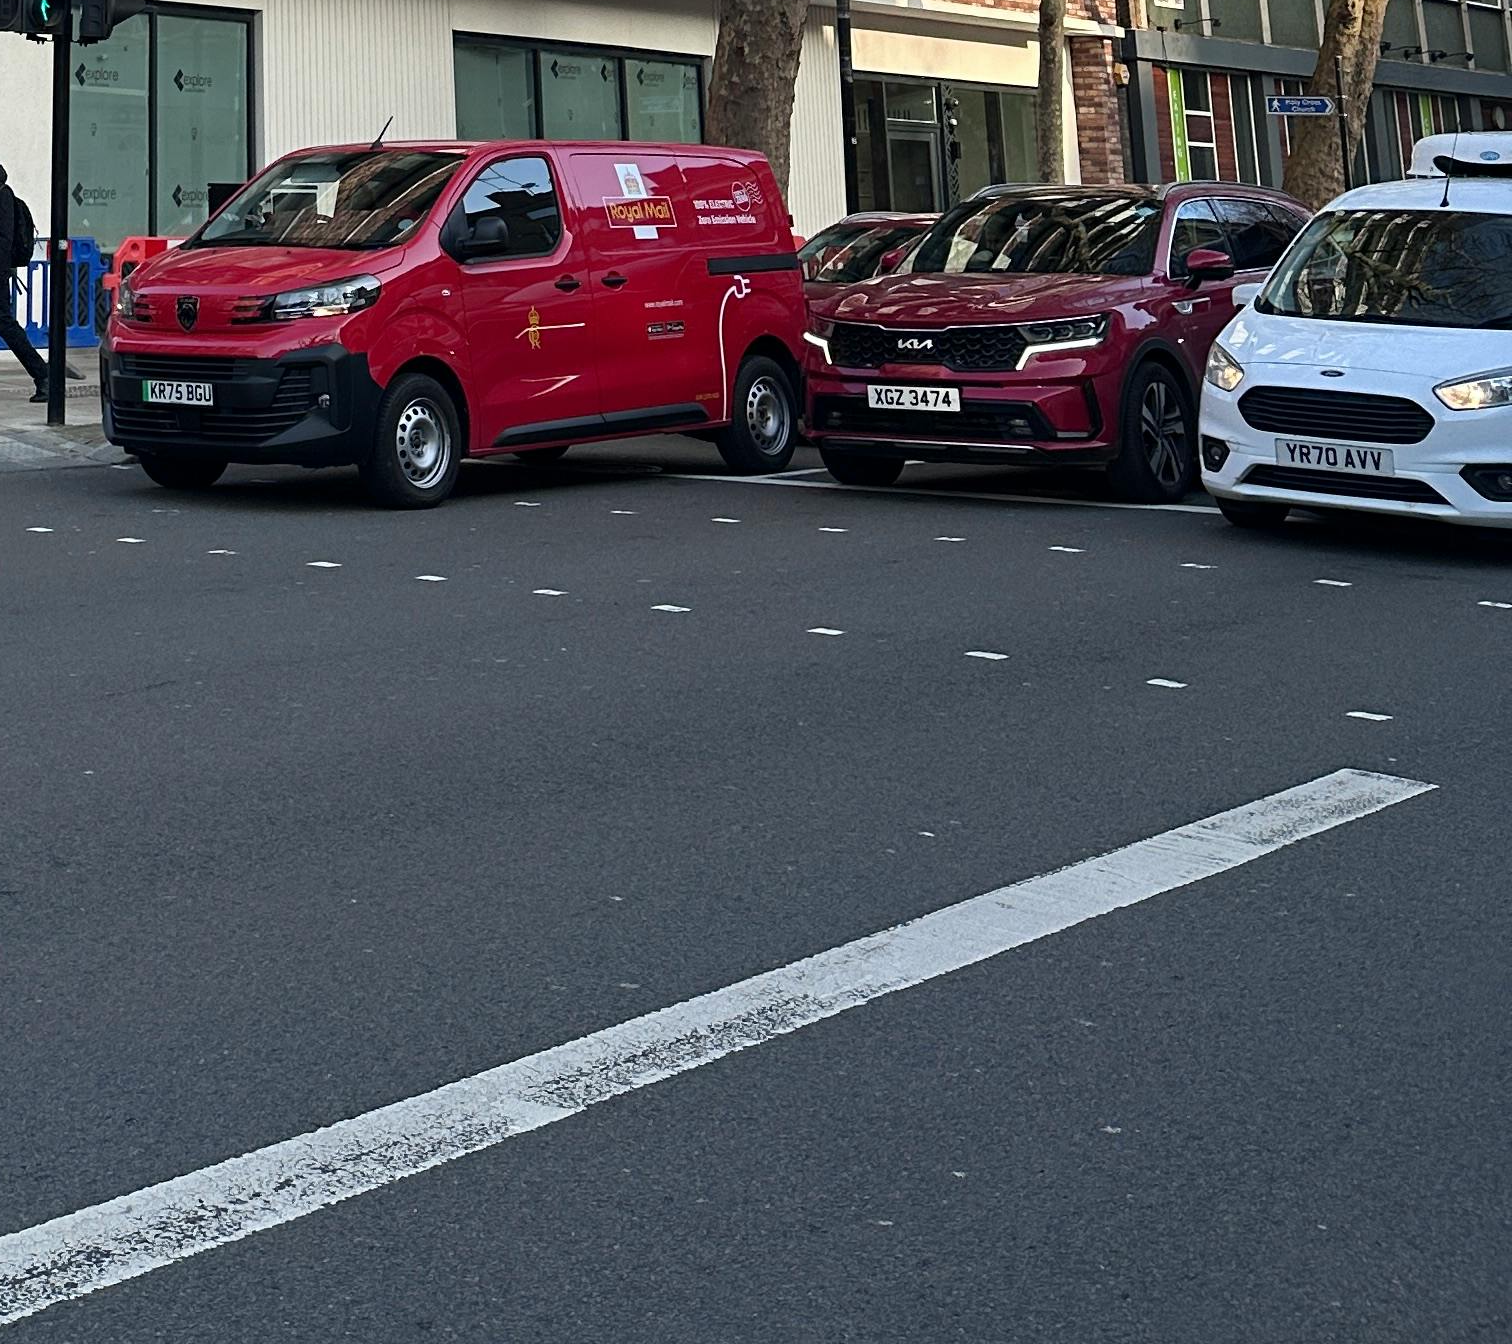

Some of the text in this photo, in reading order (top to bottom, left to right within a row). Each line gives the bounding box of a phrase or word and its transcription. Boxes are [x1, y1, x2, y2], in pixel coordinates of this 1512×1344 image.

[85, 67, 119, 81] explore
[183, 74, 213, 87] explore
[83, 186, 117, 200] explore
[181, 189, 209, 202] explor
[609, 201, 671, 223] Royal Mail
[696, 213, 757, 225] Zero Emission Vehicle
[150, 381, 212, 403] KR75 BGU
[874, 388, 952, 408] XGZ 3474
[1285, 443, 1382, 471] YR70 AVV
